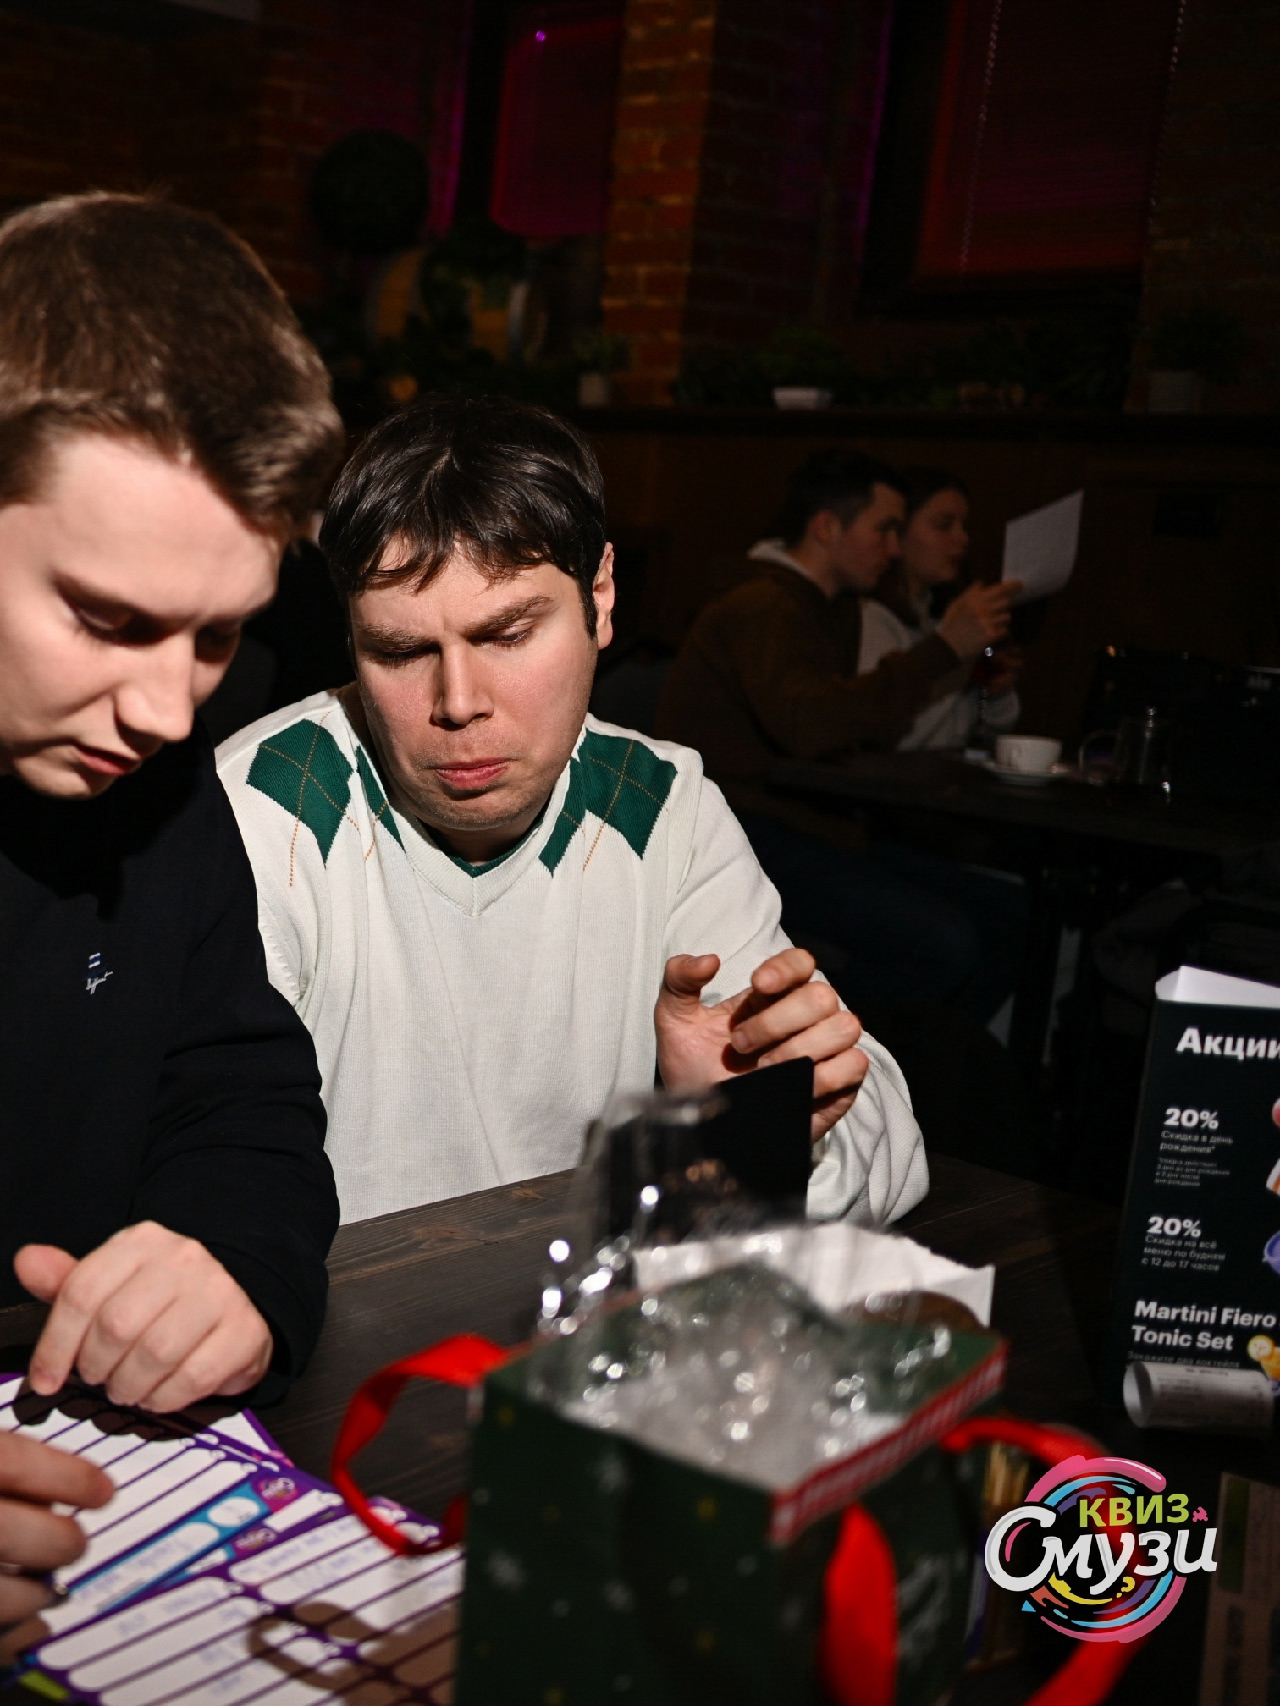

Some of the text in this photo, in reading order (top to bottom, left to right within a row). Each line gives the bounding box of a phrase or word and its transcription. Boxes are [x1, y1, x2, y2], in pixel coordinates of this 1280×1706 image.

[1164, 1107, 1219, 1130] 20%
[1147, 1216, 1201, 1238] 20%
[1151, 1257, 1161, 1267] 12
[1179, 1260, 1189, 1269] 17
[1133, 1299, 1218, 1325] Martini
[1221, 1306, 1277, 1328] Fiero
[1131, 1324, 1235, 1351] Tonic Set
